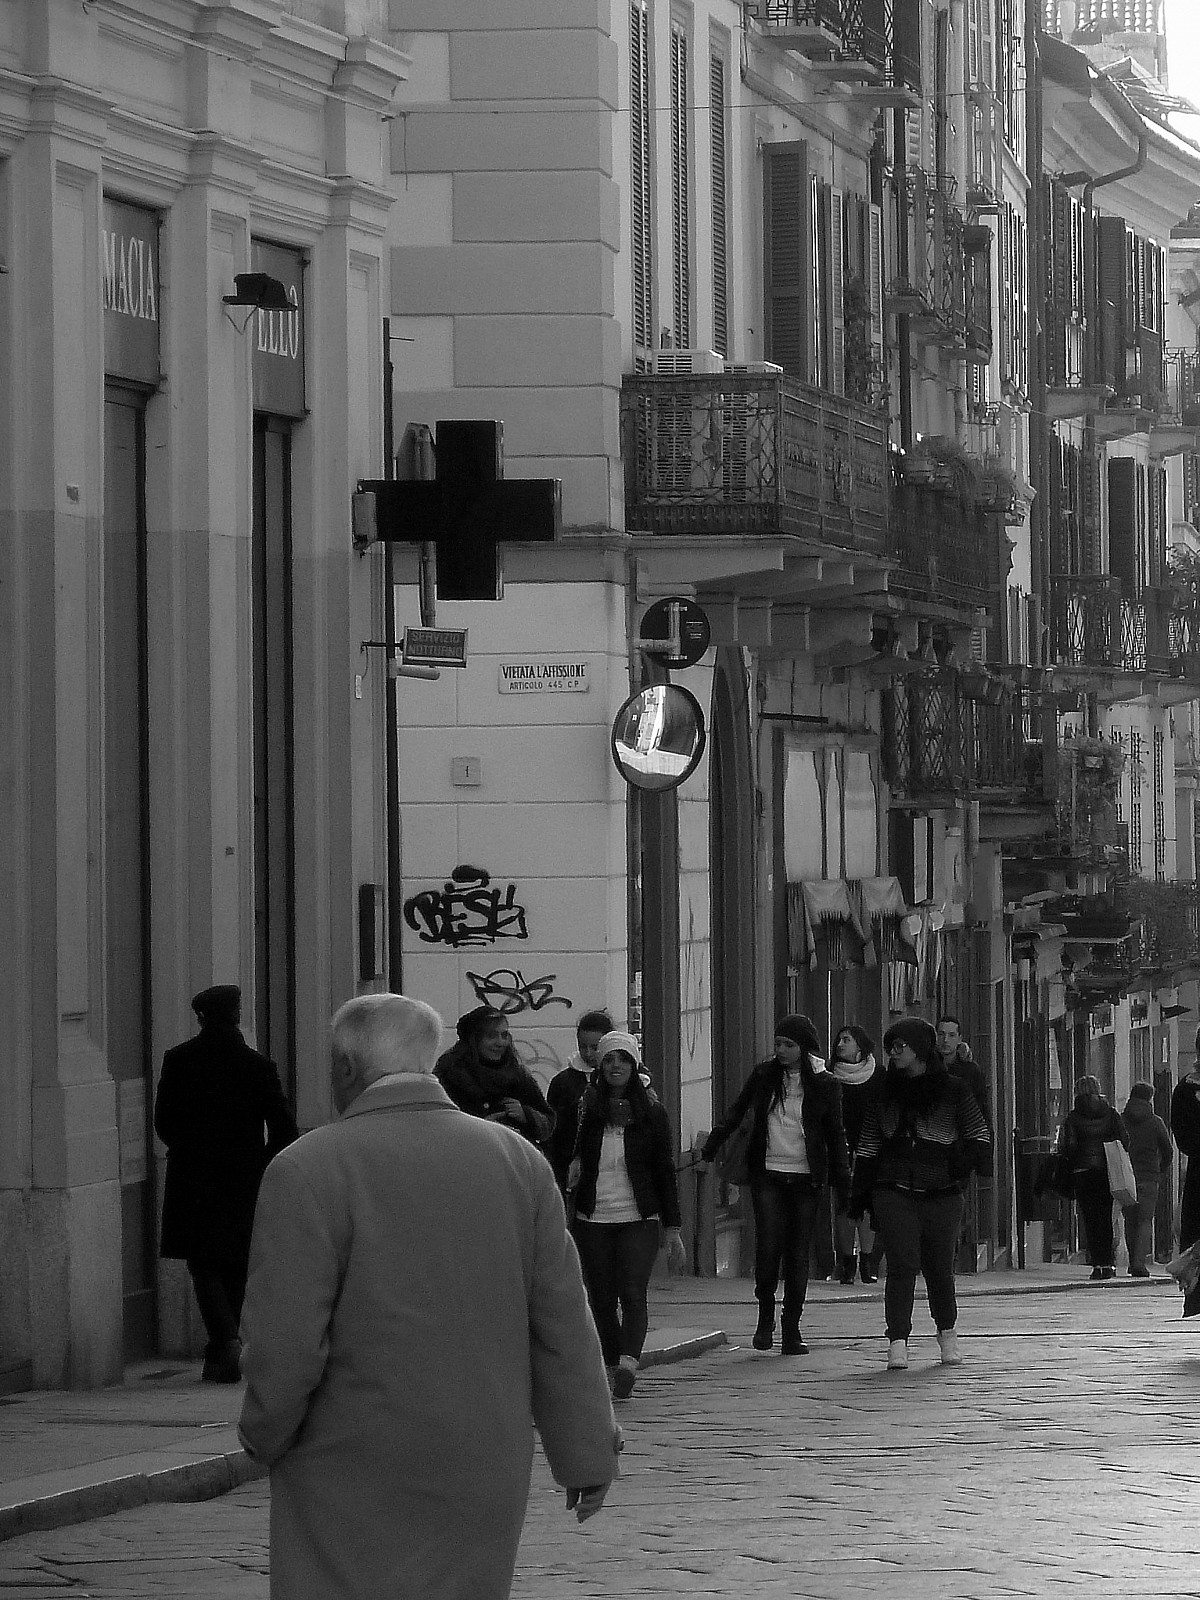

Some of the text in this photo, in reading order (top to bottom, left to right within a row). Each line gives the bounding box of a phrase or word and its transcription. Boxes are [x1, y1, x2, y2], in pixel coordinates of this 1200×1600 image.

[411, 631, 460, 643] SERVIZIO
[408, 644, 462, 657] NOTTURNO
[502, 665, 536, 679] VIETATA
[509, 681, 543, 691] ARTICOLO
[548, 681, 562, 689] 445
